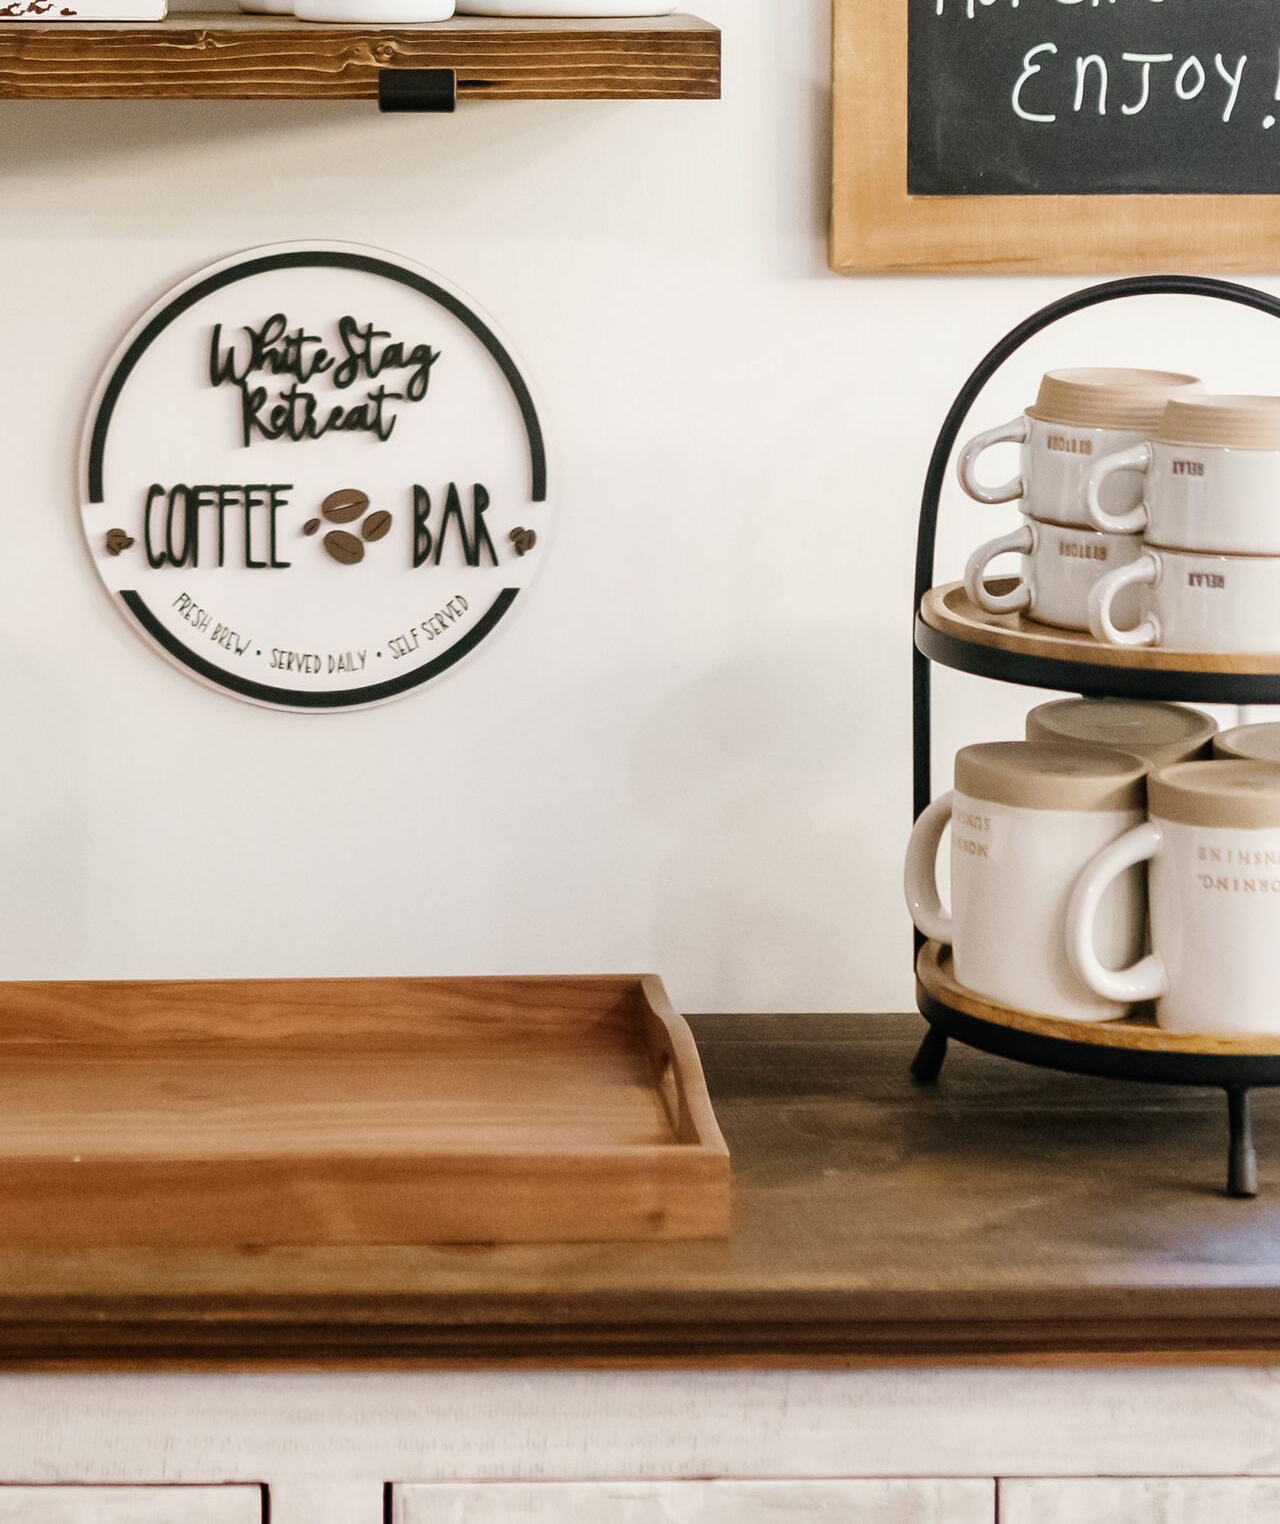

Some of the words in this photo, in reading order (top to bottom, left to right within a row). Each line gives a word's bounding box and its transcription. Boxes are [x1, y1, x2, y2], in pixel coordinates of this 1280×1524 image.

[209, 313, 334, 387] White
[333, 315, 442, 402] Stag
[241, 380, 398, 447] Retreat
[1172, 460, 1205, 477] RELAX
[144, 483, 294, 569] COFFEE
[412, 481, 499, 569] BAR
[1188, 572, 1225, 589] RELAX
[171, 592, 212, 633] FRESH
[210, 622, 252, 657] BREW
[270, 648, 322, 675] SERVED
[327, 649, 368, 674] DAILY
[387, 628, 422, 660] SELF
[419, 594, 471, 641] SERVED
